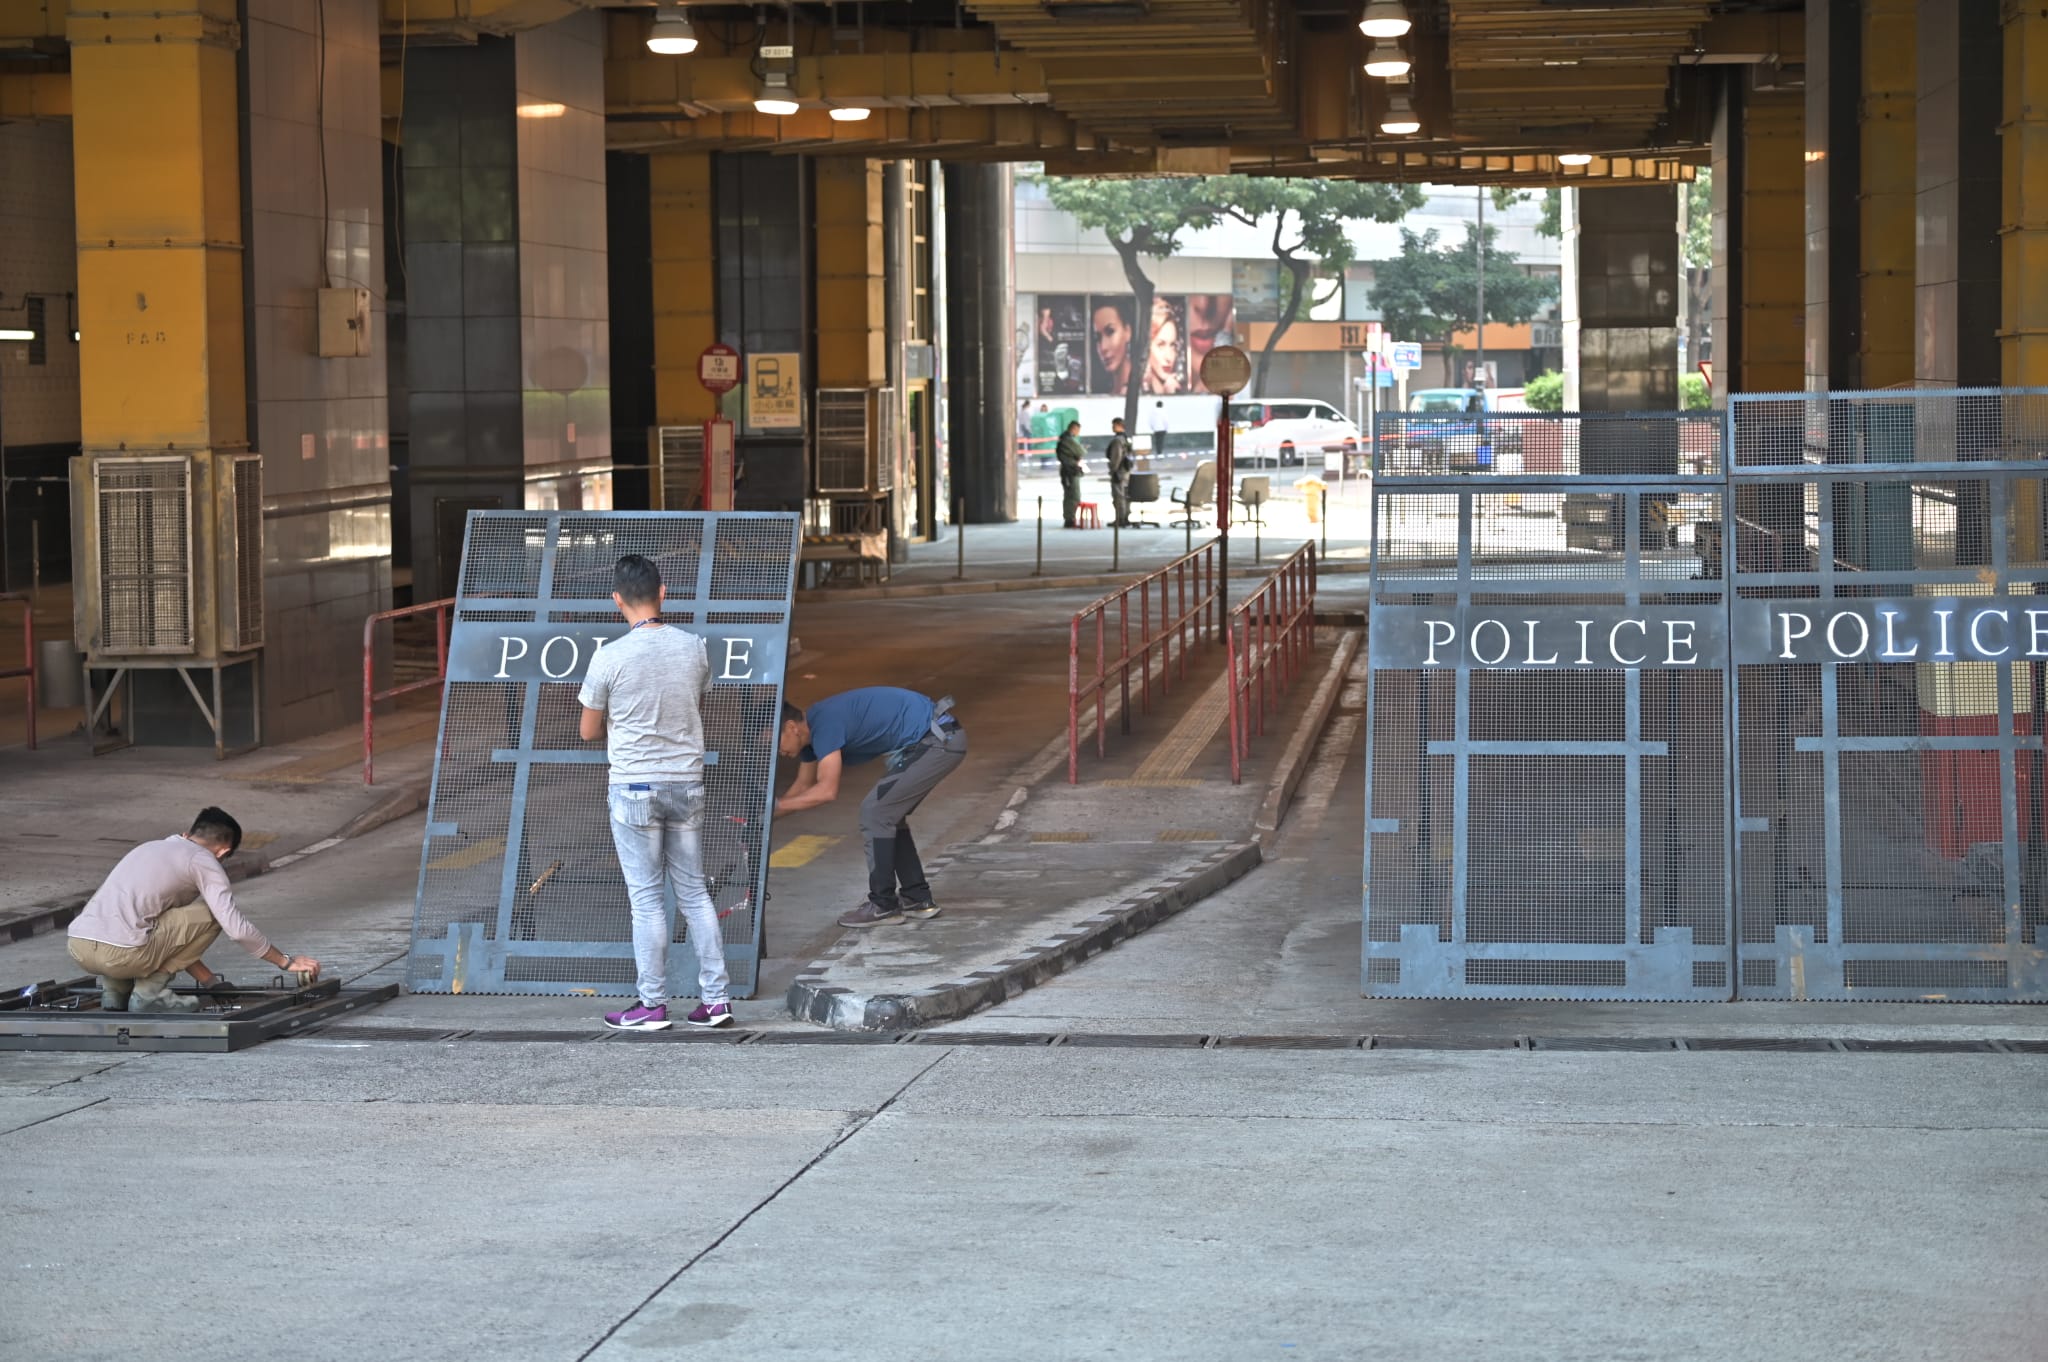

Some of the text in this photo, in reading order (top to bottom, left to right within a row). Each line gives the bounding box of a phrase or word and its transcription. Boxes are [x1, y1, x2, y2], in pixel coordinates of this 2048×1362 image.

[1422, 619, 1698, 665] POLICE
[1778, 609, 2048, 658] POLICE
[494, 635, 754, 679] POE
